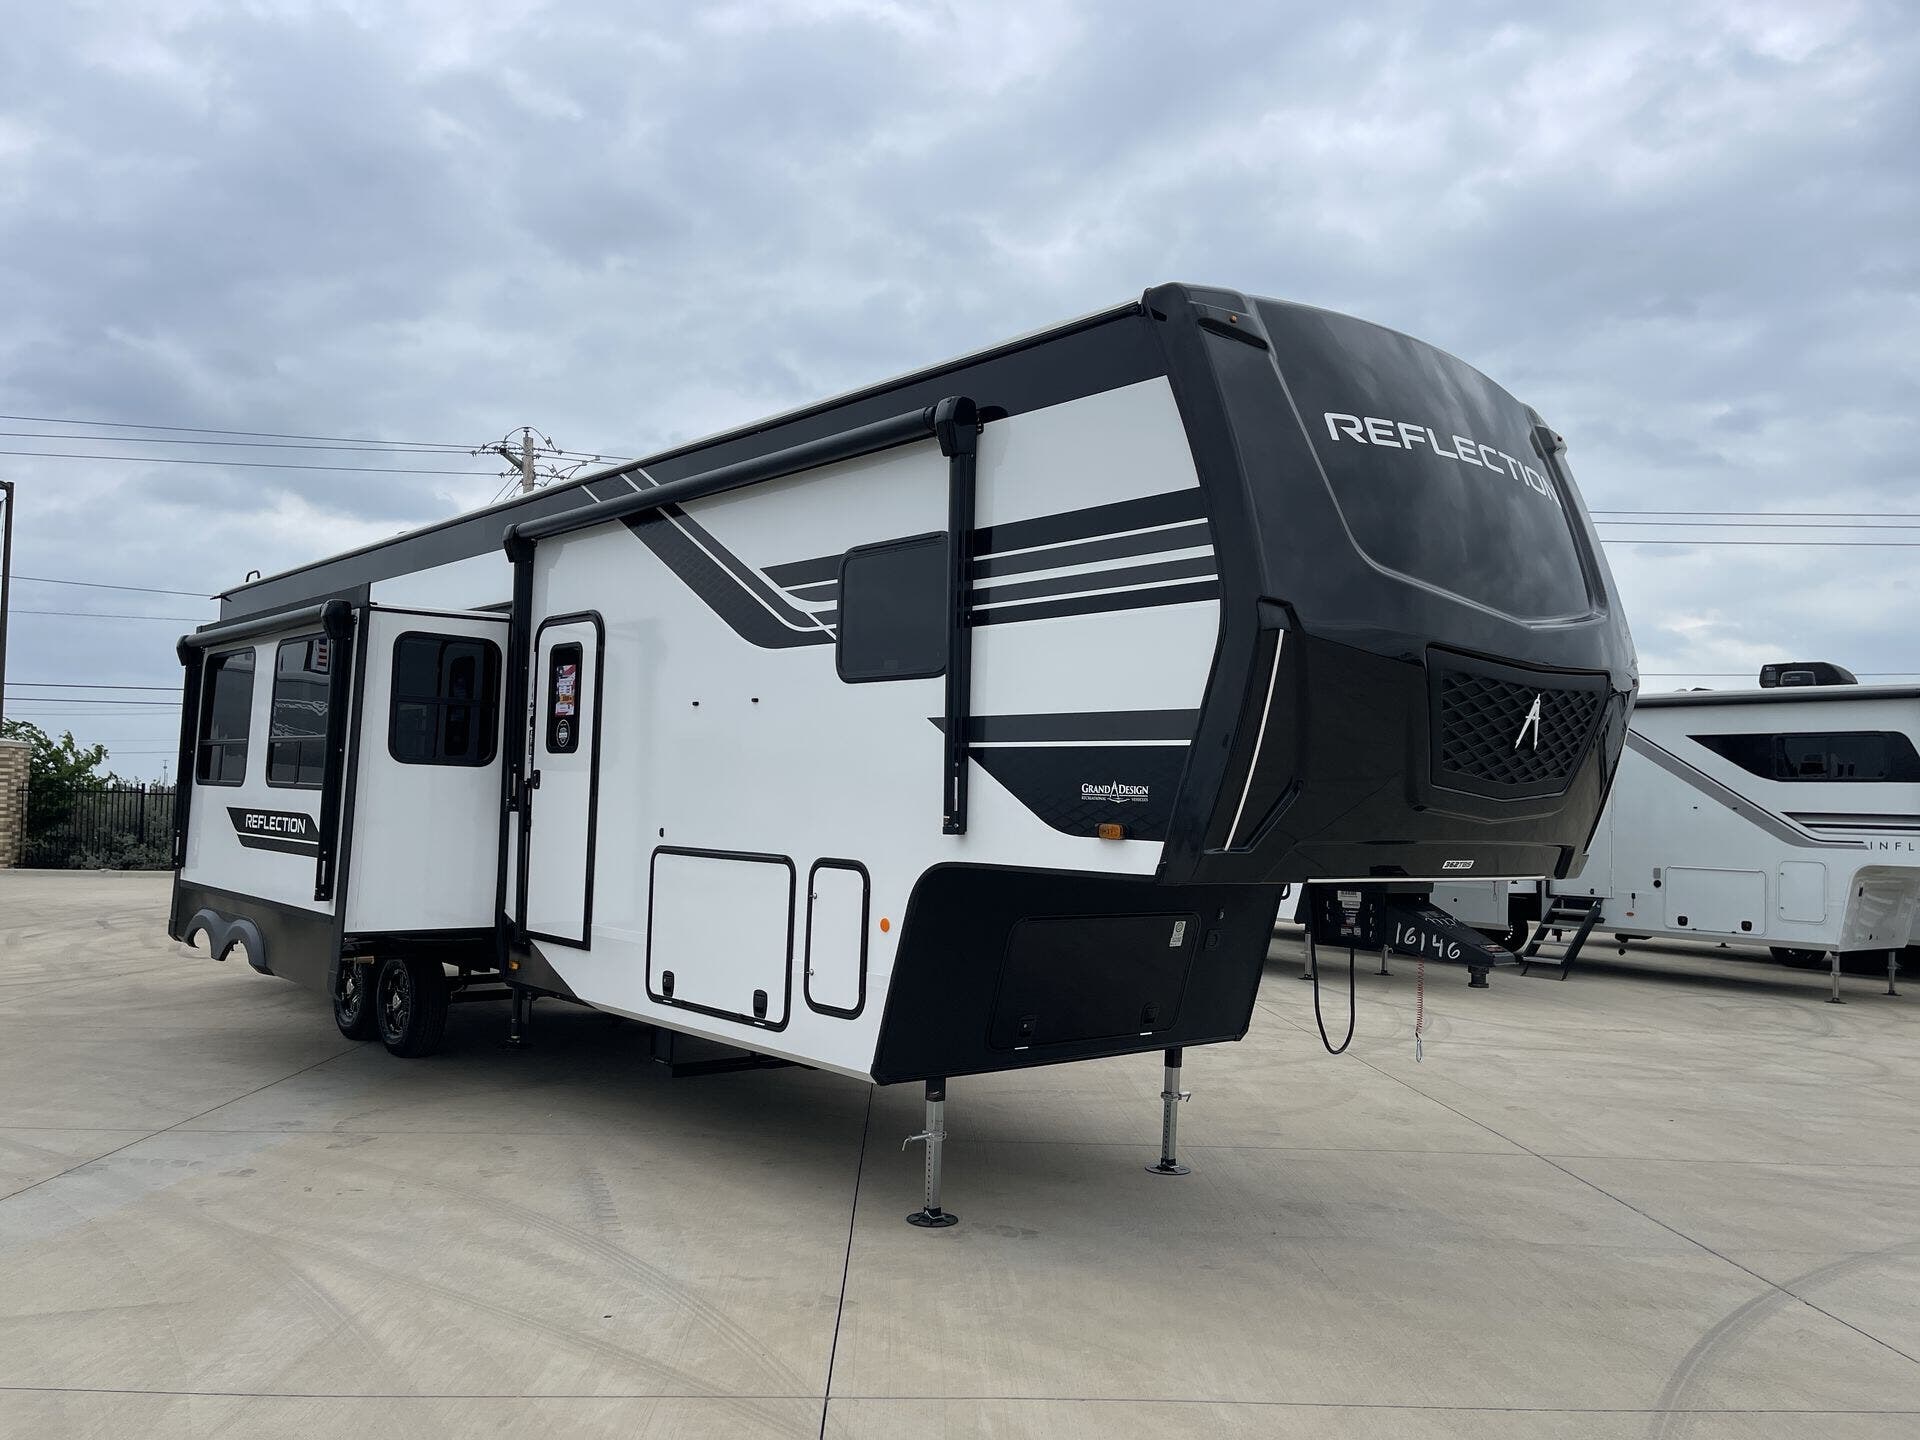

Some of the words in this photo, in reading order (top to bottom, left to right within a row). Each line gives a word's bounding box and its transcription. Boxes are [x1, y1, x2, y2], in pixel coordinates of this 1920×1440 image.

[1324, 412, 1562, 509] REFLECTION
[1081, 783, 1111, 794] GRAND
[1118, 784, 1149, 795] DESIGN
[245, 813, 306, 834] REFLECTION
[1870, 841, 1915, 851] INFL
[1395, 921, 1461, 959] 16146
